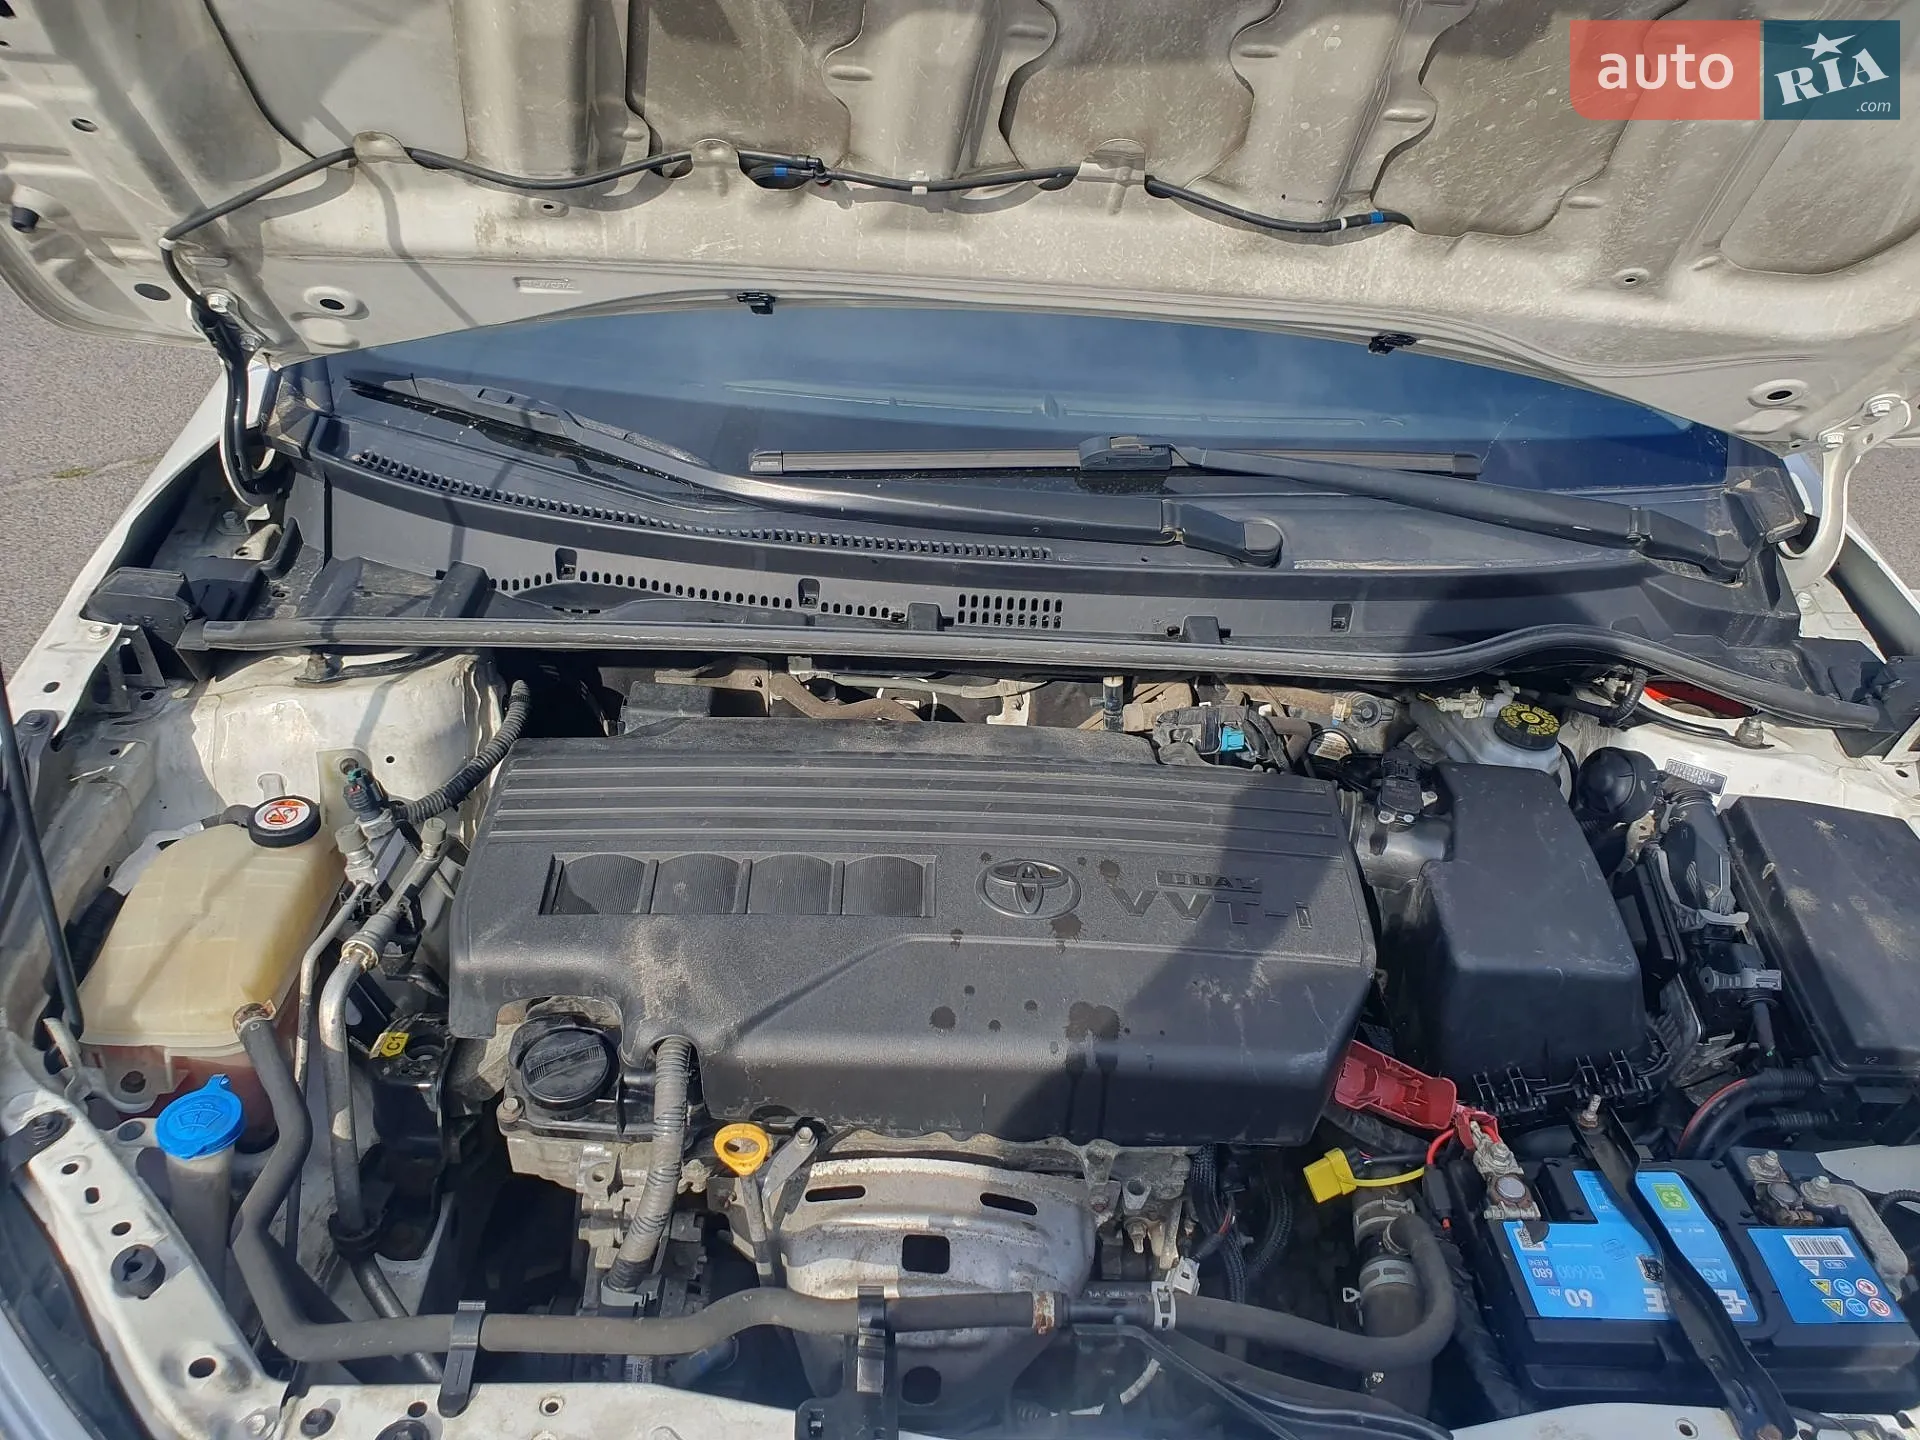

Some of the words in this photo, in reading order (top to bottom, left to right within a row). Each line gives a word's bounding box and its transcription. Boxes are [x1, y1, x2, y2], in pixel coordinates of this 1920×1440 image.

[387, 1036, 405, 1051] C1
[1532, 1267, 1553, 1279] 680
[1699, 1268, 1728, 1283] AG
[1564, 1288, 1594, 1308] 60
